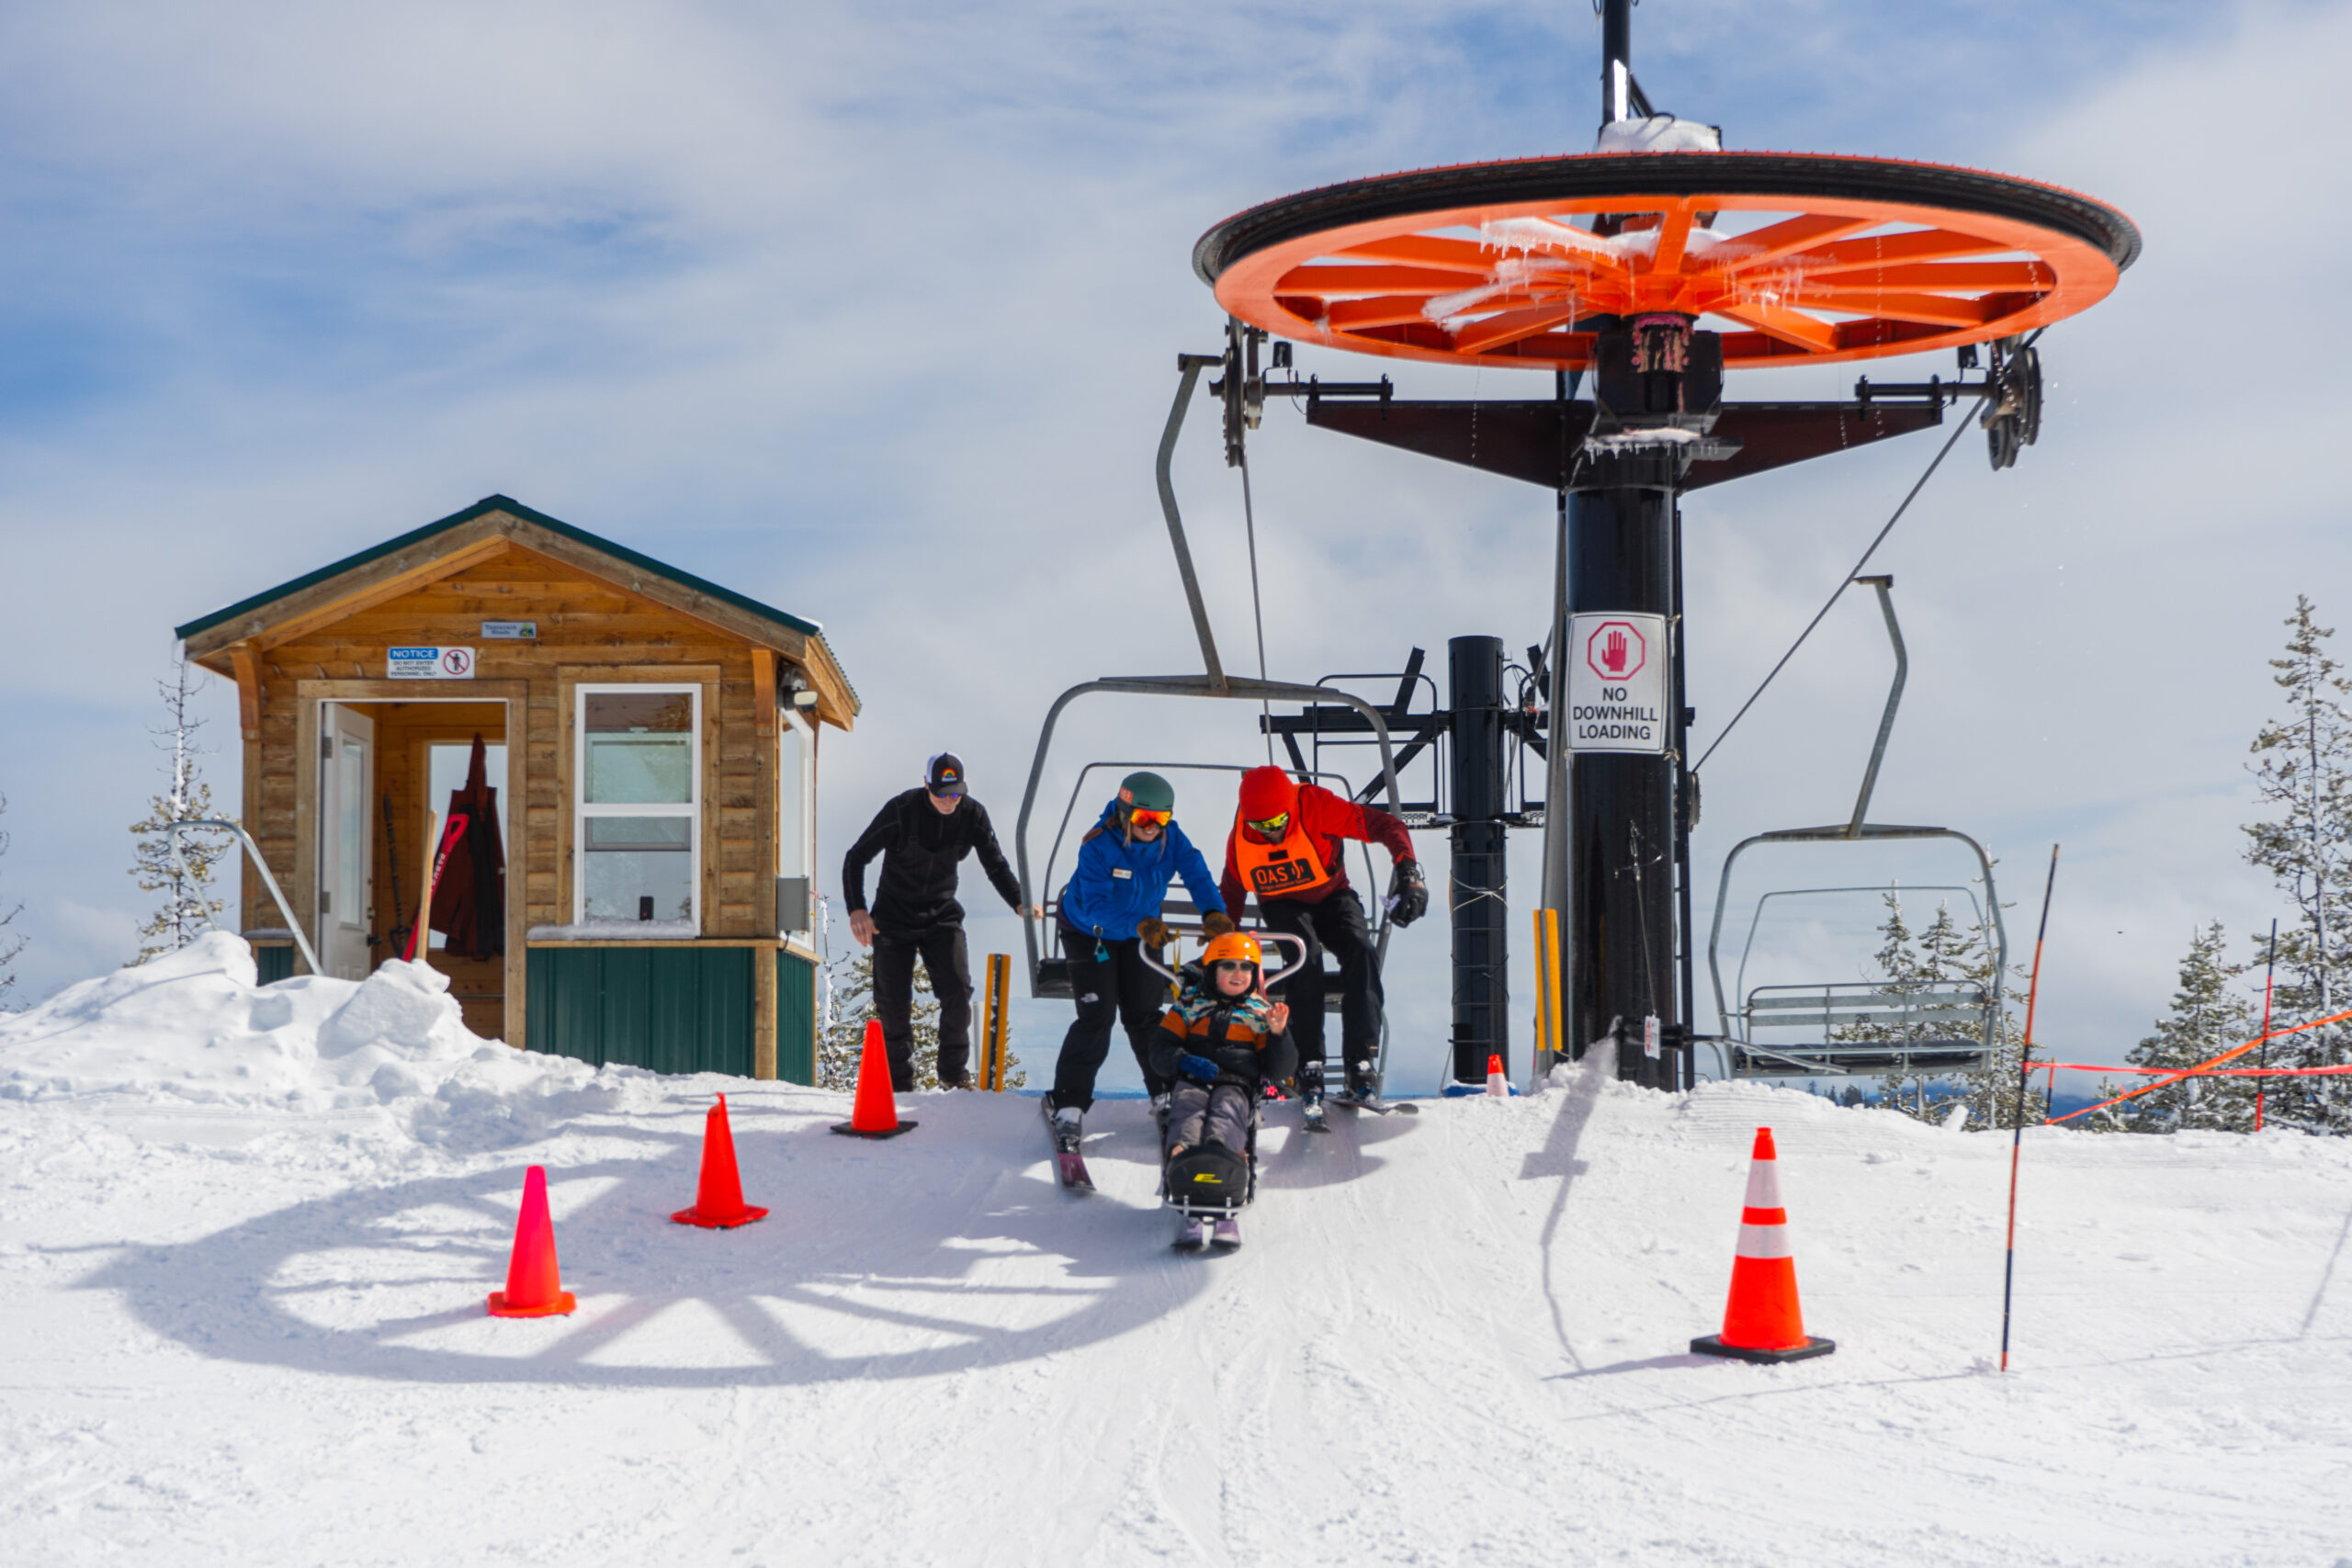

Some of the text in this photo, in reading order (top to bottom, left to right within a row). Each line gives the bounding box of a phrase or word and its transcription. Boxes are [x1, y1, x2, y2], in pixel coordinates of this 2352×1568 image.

[392, 649, 435, 659] NOTICE
[1602, 687, 1627, 702] NO
[1573, 706, 1657, 721] DOWNHILL
[1578, 725, 1651, 740] LOADING
[1256, 866, 1288, 885] OAS
